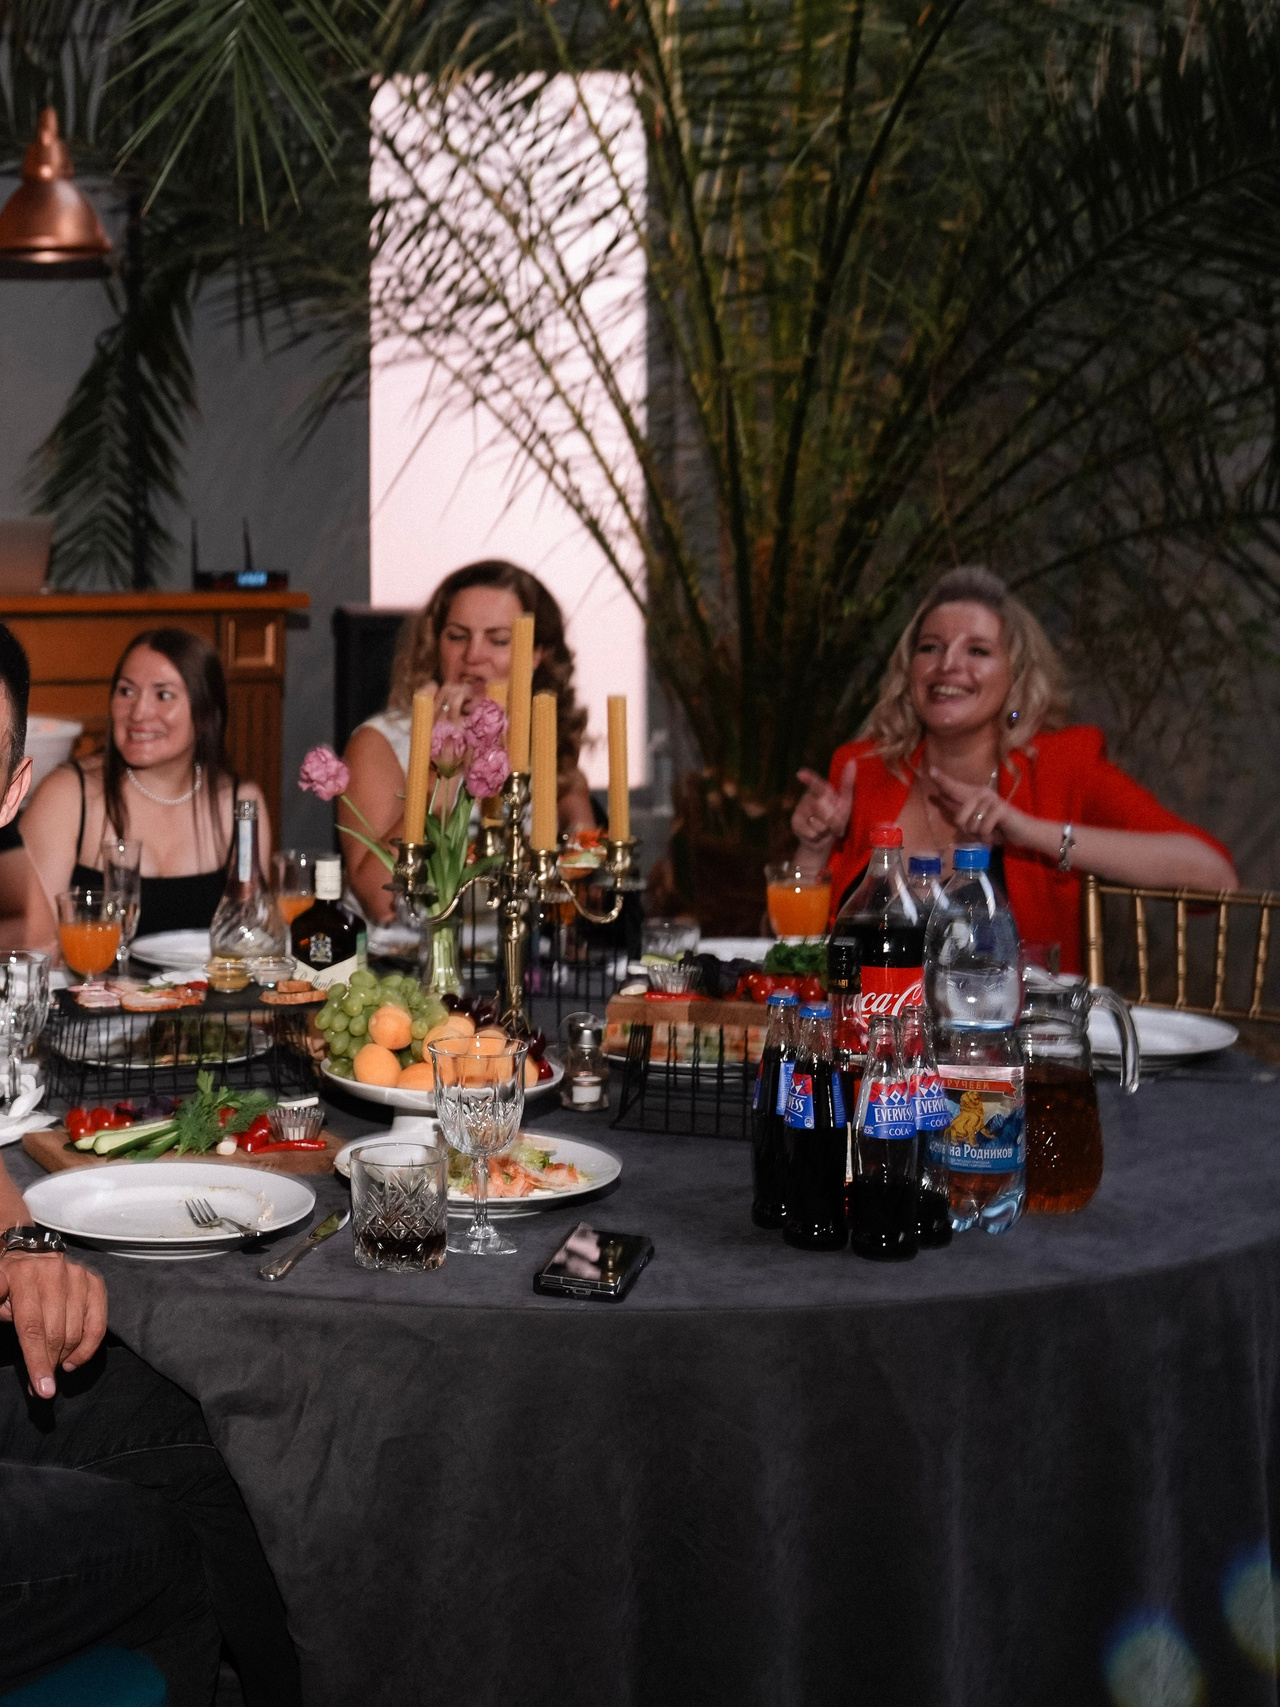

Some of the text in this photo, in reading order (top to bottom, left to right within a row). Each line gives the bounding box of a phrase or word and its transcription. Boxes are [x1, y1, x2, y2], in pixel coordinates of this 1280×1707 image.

[787, 1095, 805, 1113] VESS
[874, 1106, 914, 1123] EVERVESS
[888, 1128, 909, 1136] COLA
[963, 1143, 1013, 1160] Родников
